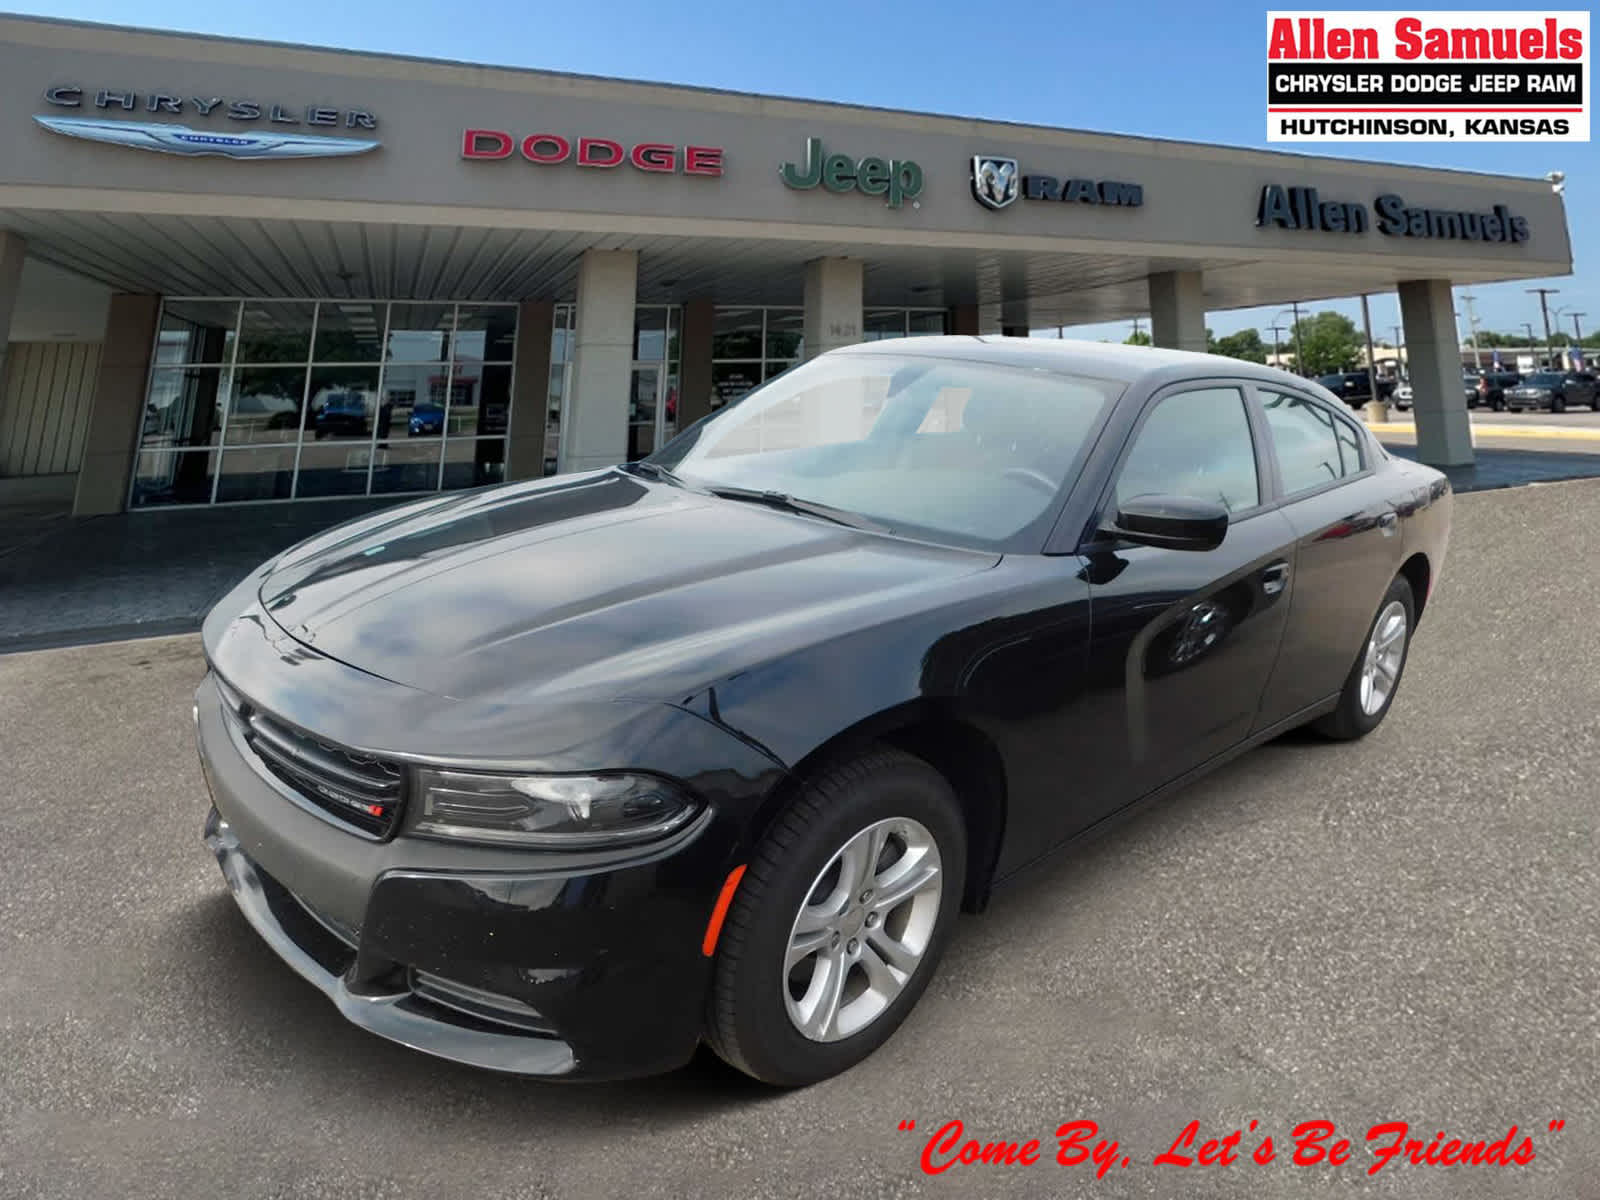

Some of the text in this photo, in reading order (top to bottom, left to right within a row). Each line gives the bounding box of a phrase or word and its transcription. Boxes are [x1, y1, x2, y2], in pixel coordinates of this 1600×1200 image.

[44, 86, 378, 130] CHRYSLER
[461, 129, 724, 176] DODGE
[779, 136, 923, 208] Jeep
[1022, 175, 1144, 207] RAM
[1255, 184, 1530, 243] Allen Samuels
